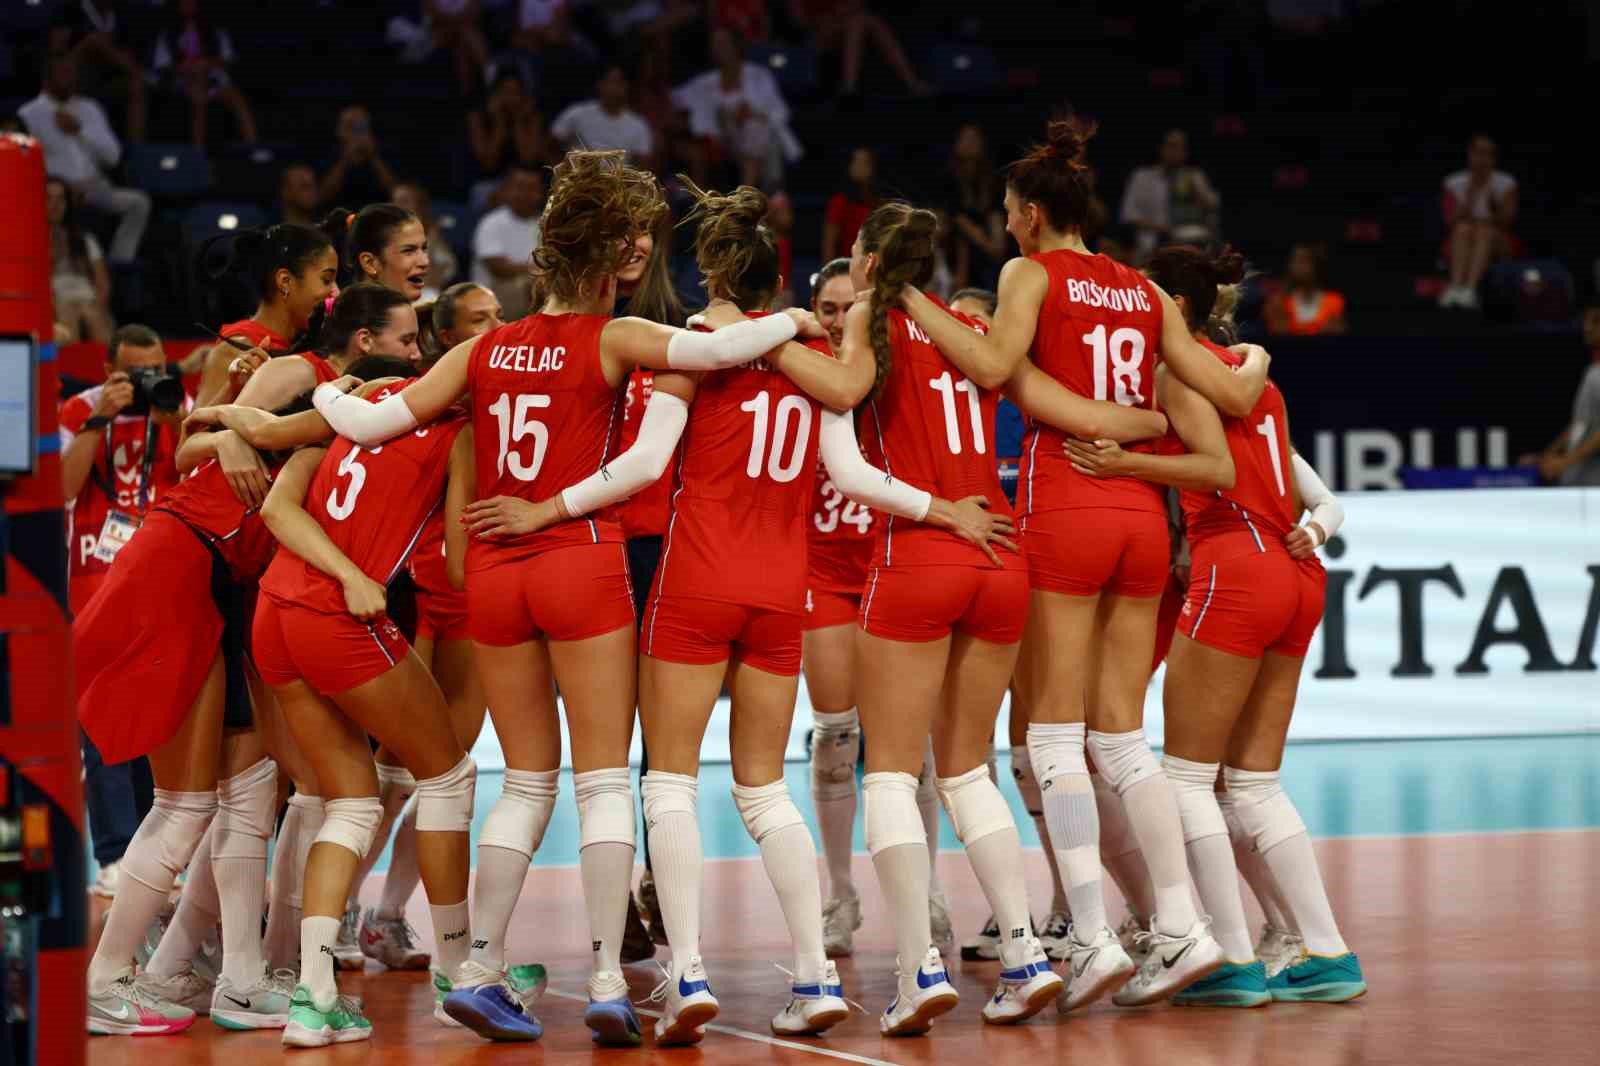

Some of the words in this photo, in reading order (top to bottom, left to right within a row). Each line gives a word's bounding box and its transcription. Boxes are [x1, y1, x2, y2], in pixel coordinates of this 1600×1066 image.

[1066, 277, 1151, 312] BOŠKOVIĆ
[489, 344, 566, 372] UZELAC
[1081, 323, 1146, 407] 18
[488, 392, 551, 482] 15
[740, 390, 813, 483] 10
[929, 370, 986, 455] 11
[326, 445, 383, 521] 5
[1256, 413, 1286, 497] 1
[814, 480, 873, 535] 34
